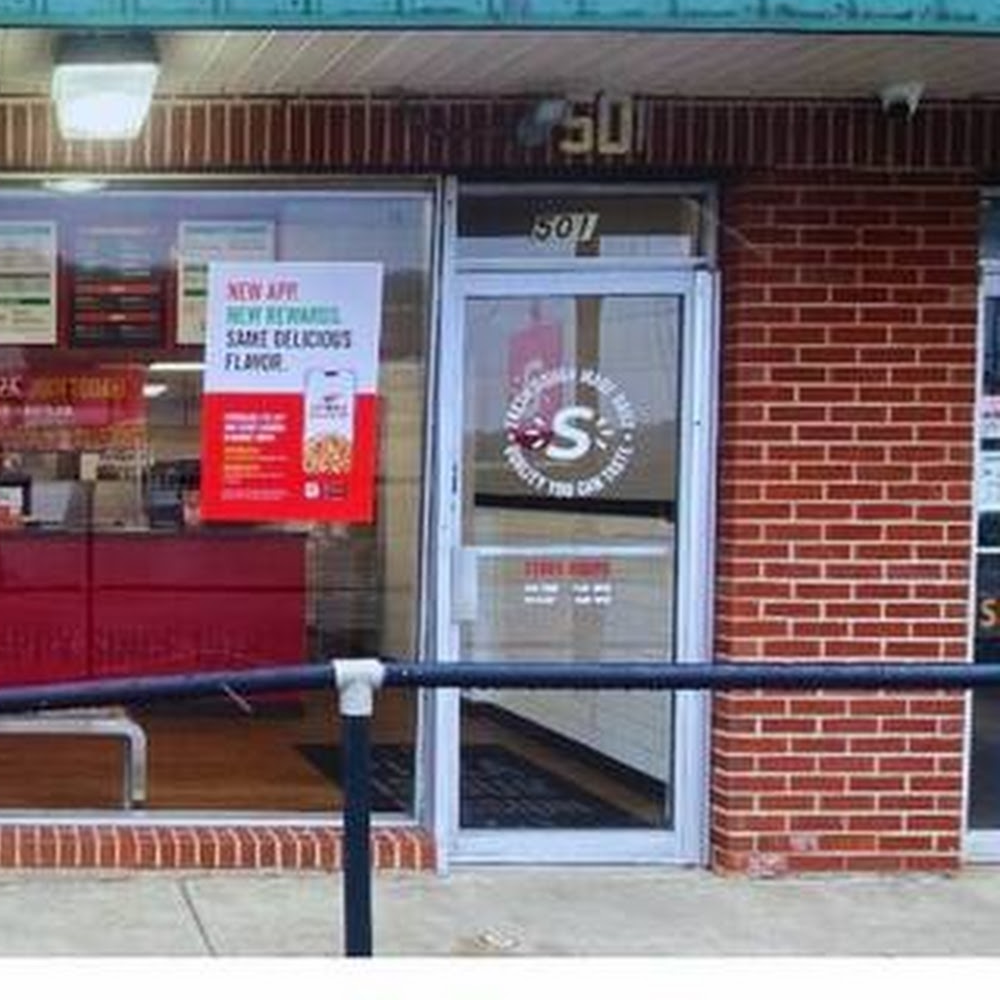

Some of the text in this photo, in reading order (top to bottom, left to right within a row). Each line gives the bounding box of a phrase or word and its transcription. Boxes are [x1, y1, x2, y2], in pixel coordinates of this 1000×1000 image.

[531, 213, 599, 244] 501
[227, 281, 263, 300] NEW
[226, 329, 352, 349] SAME DELICIOUS
[546, 406, 592, 460] S
